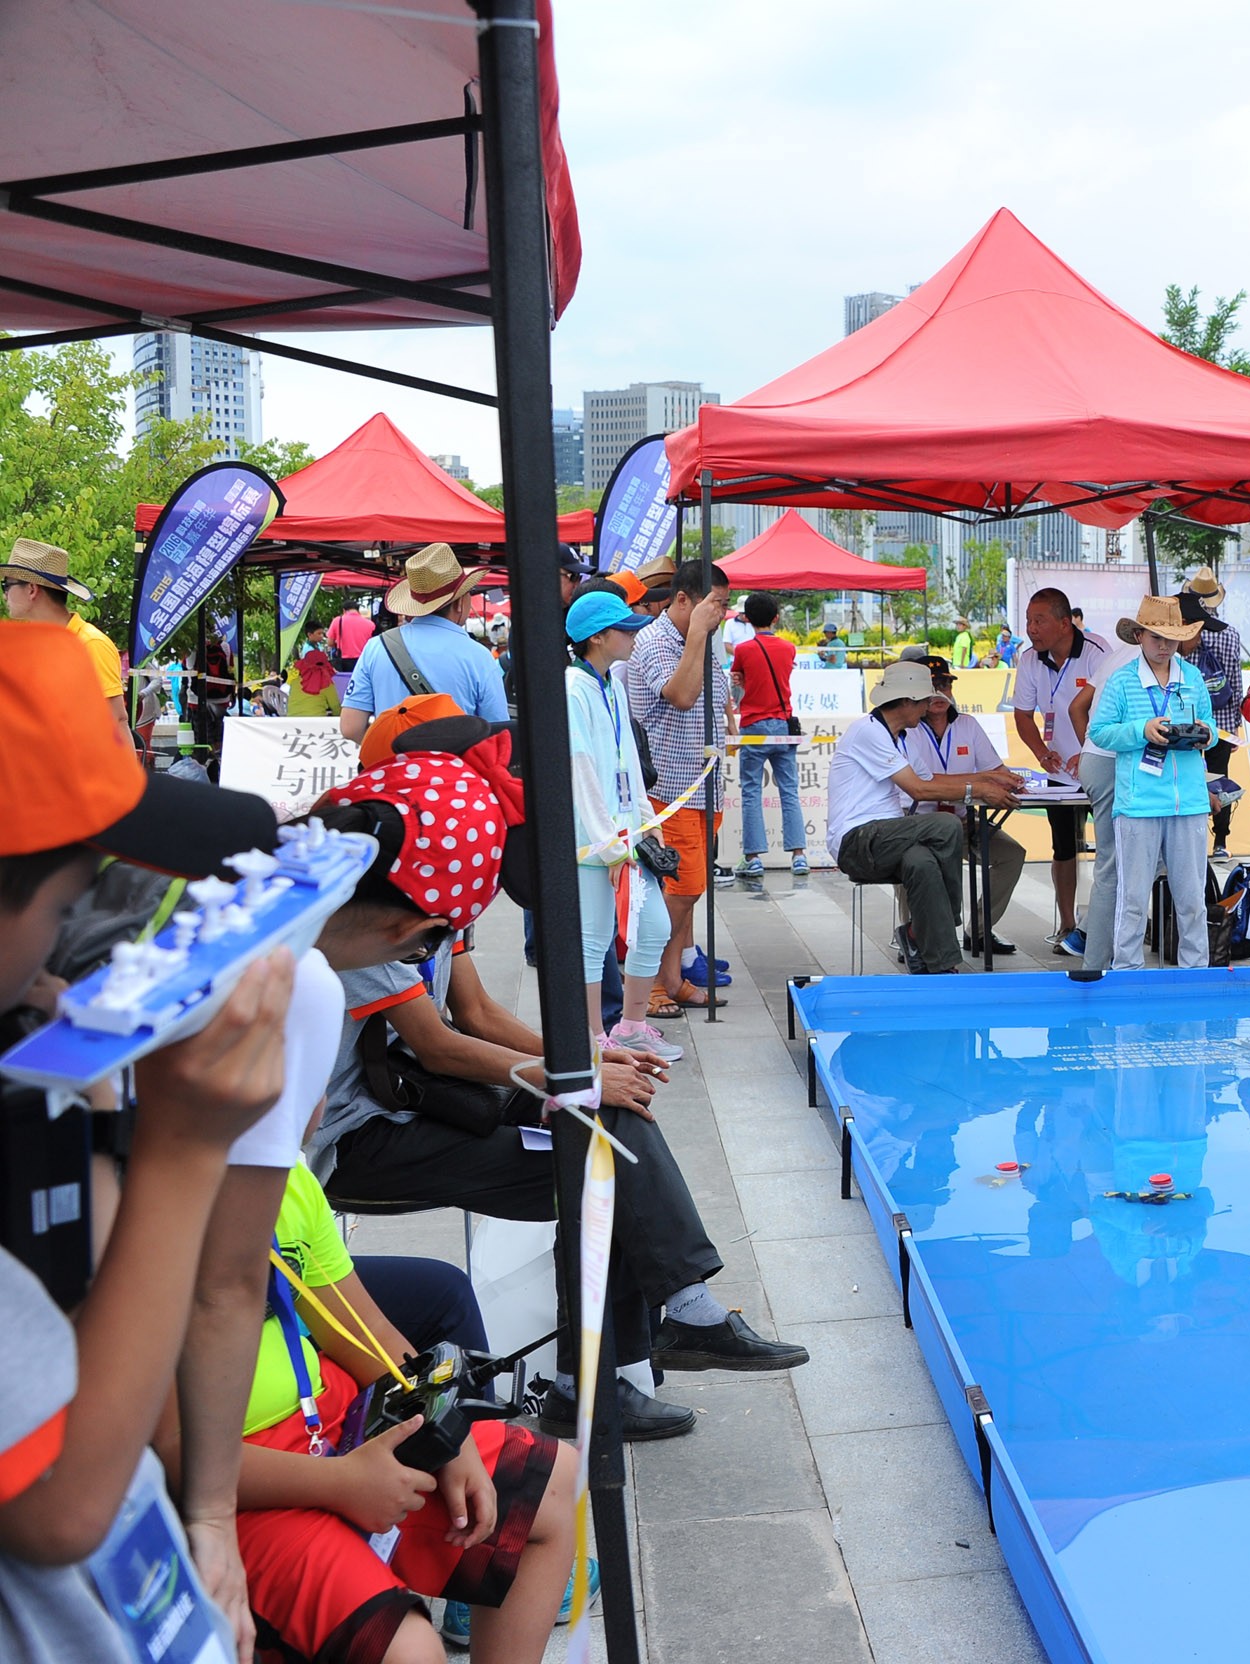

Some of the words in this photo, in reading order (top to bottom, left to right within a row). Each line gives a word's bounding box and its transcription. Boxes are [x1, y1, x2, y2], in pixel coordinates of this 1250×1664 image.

[185, 507, 217, 545] 嘉年华
[149, 486, 263, 629] 全国航海模型锦标赛
[160, 533, 182, 557] 2016
[151, 575, 173, 603] 2016
[797, 693, 839, 711] 传媒
[282, 728, 359, 760] 安家
[272, 765, 358, 796] 与世
